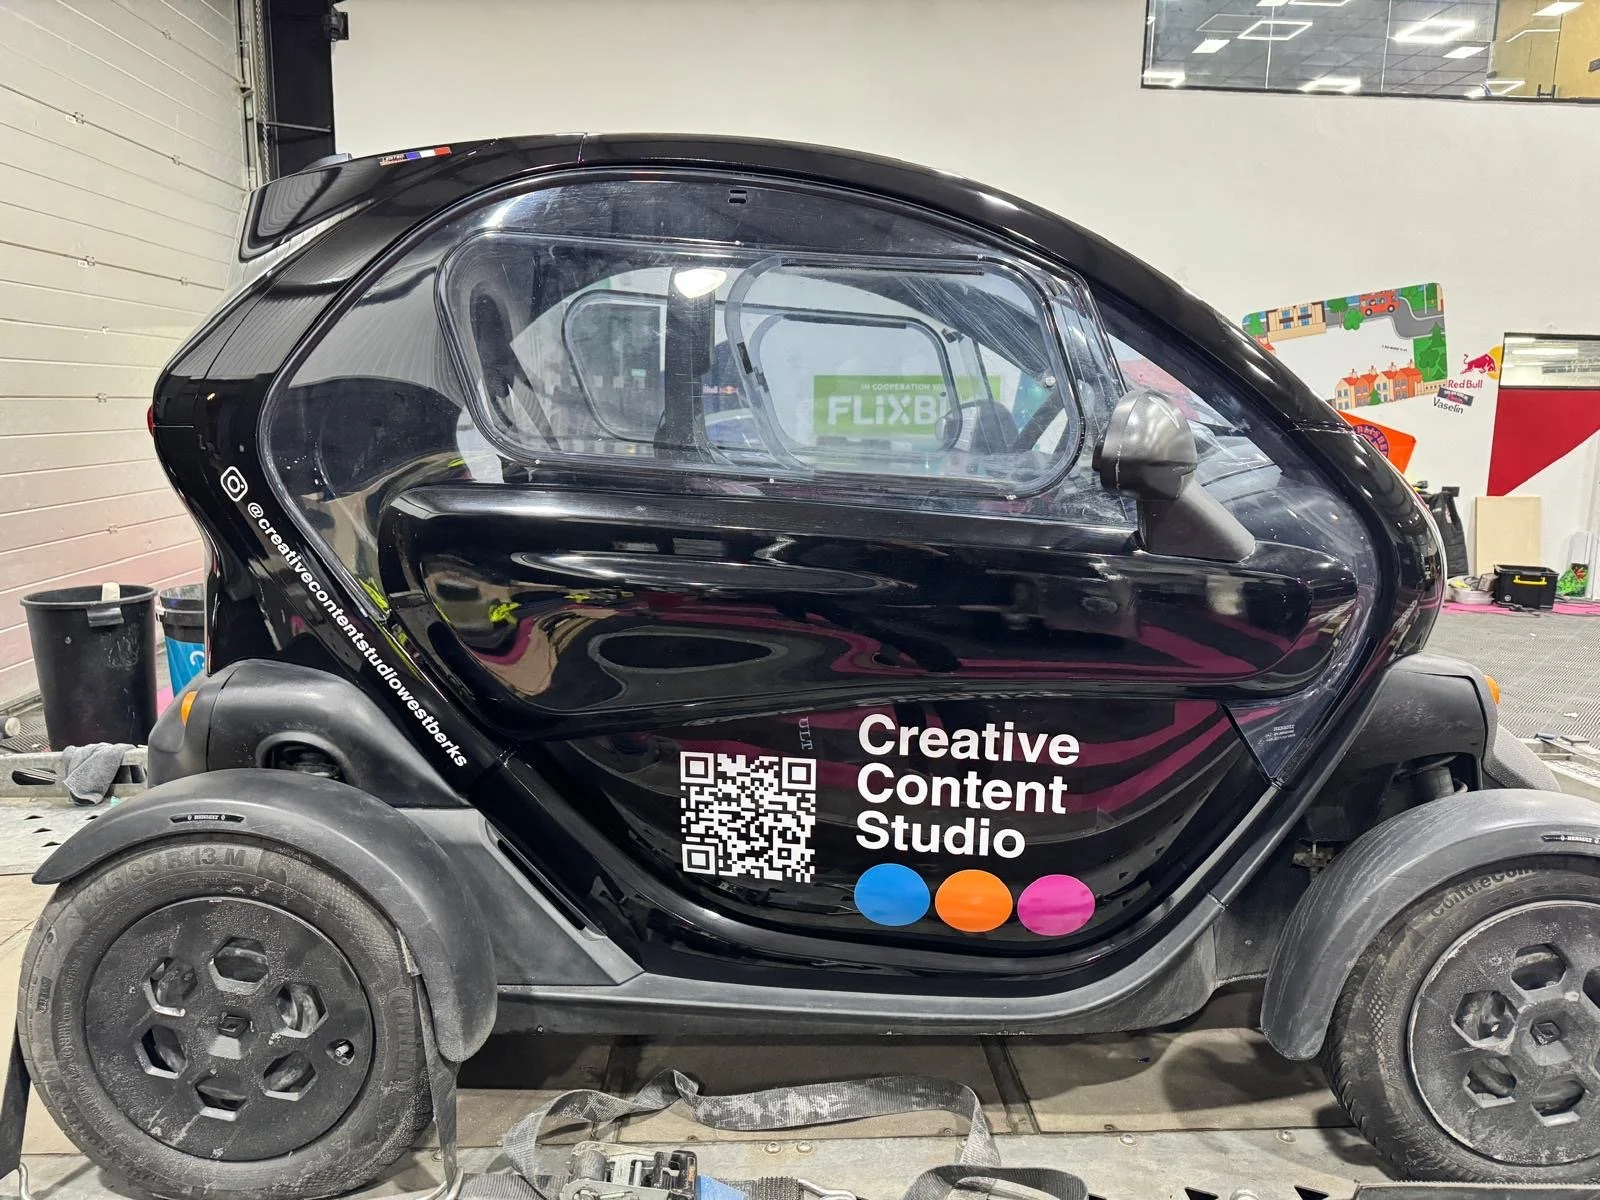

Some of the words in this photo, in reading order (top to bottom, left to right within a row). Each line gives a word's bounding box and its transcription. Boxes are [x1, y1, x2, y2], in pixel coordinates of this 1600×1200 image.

[872, 383, 930, 391] COOPERATION
[1433, 397, 1464, 414] Vaselin
[1447, 379, 1466, 389] Red
[1467, 379, 1483, 389] Bull
[247, 502, 468, 768] @creativecontentstudiowestberks
[858, 713, 1080, 766] Creative
[857, 762, 1067, 815] Content
[856, 810, 1026, 859] Studio
